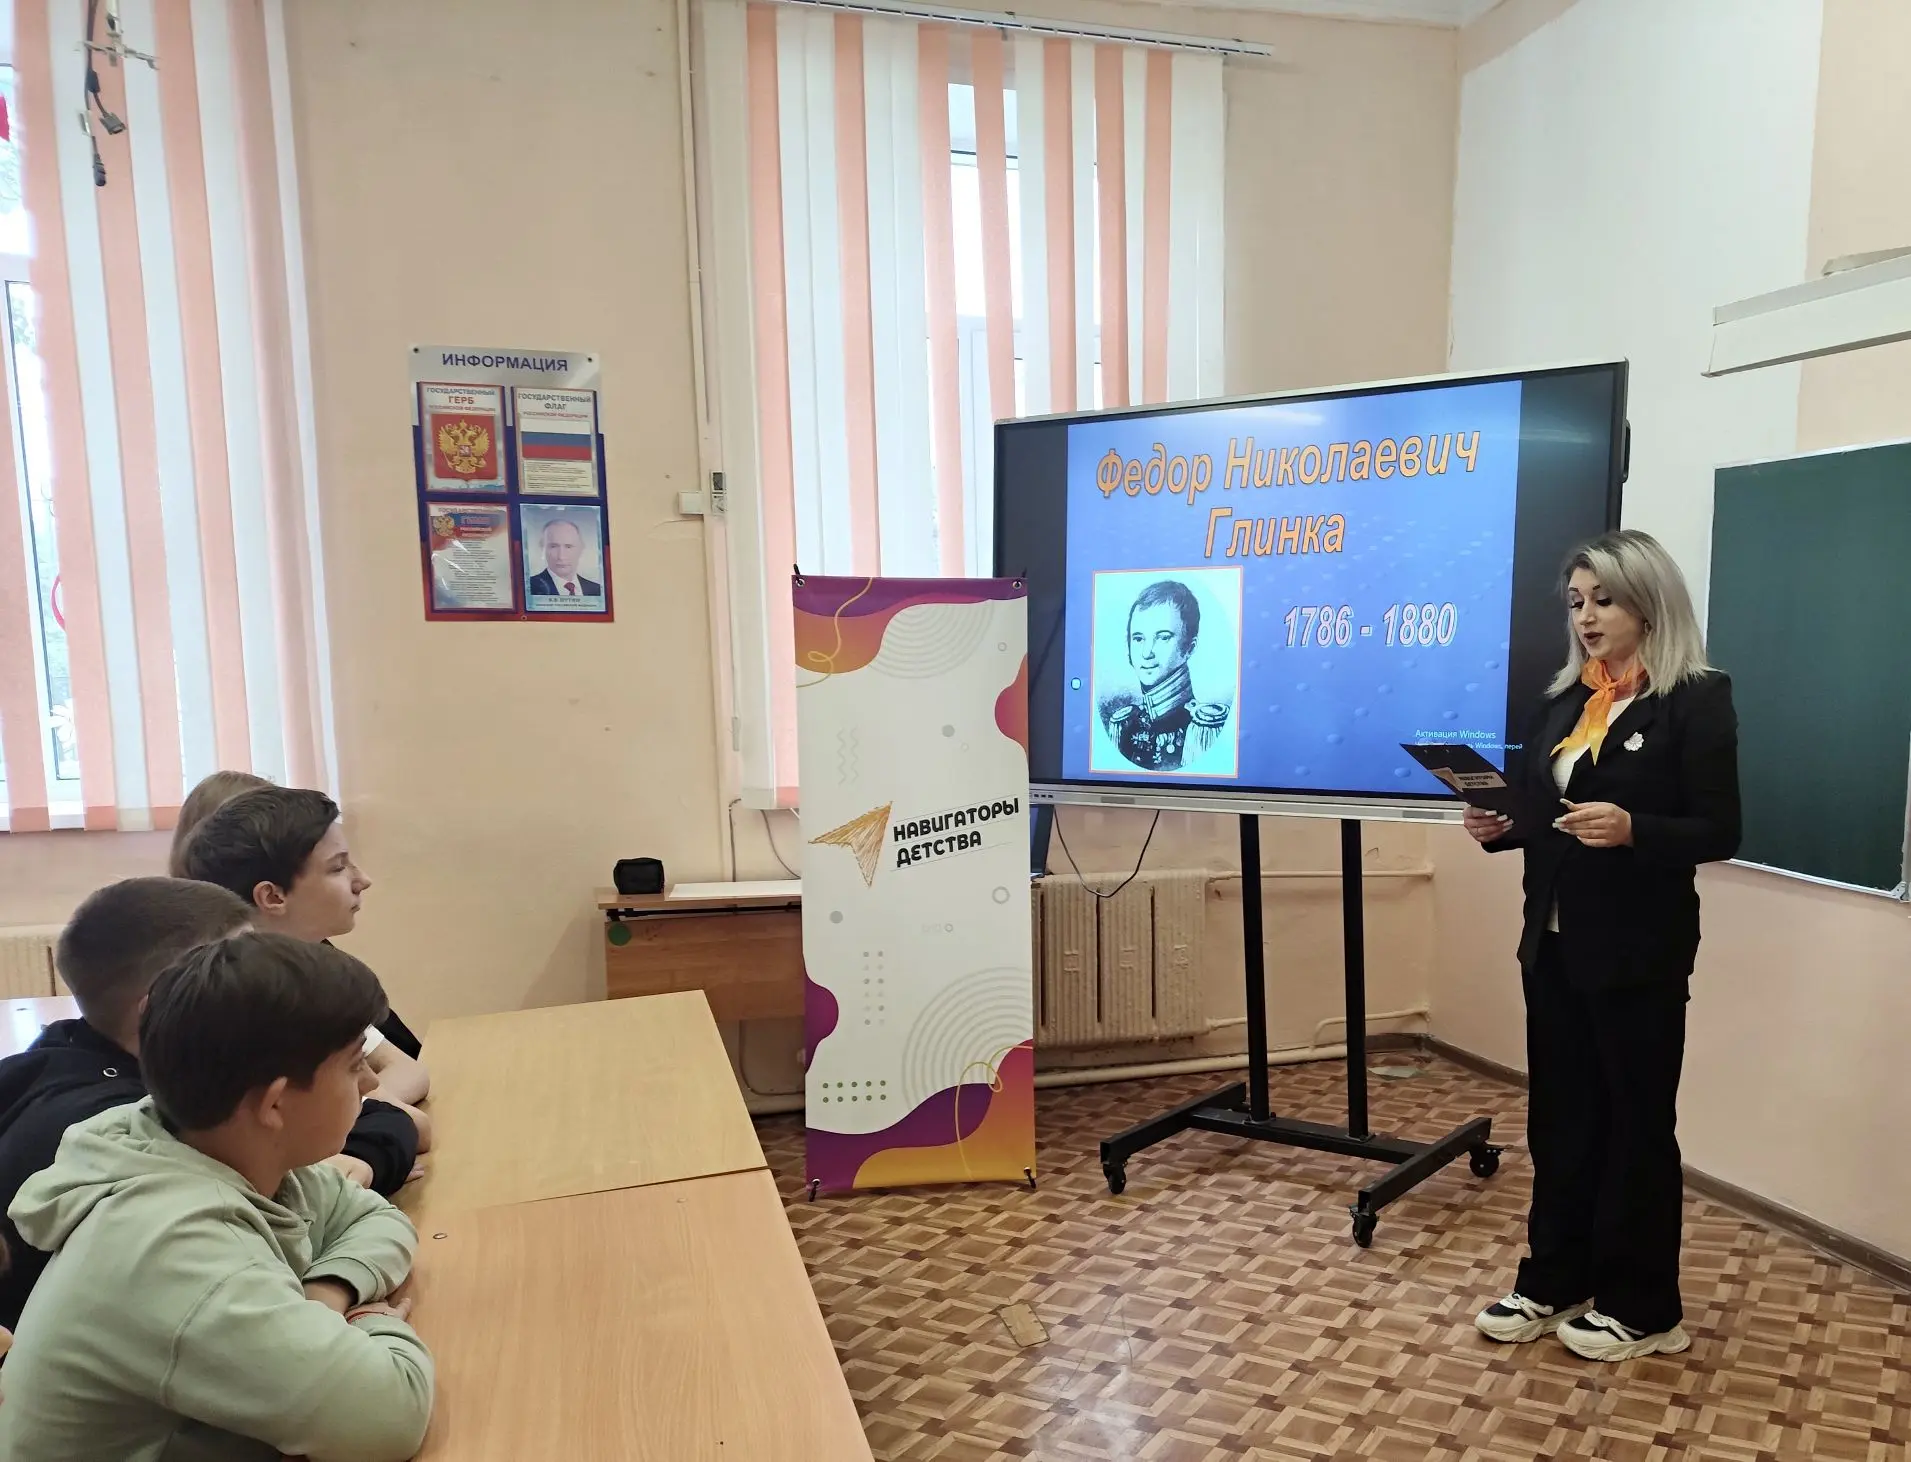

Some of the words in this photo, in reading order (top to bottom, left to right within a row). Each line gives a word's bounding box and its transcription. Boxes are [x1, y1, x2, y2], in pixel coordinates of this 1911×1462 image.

[441, 353, 569, 372] ИНФОРМАЦИЯ
[448, 395, 475, 405] ГЕРБ
[517, 392, 591, 403] ГОСУДАРСТВЕННЫЙ
[544, 402, 567, 410] ФЛАГ
[1096, 442, 1214, 505] Федор
[1223, 430, 1481, 490] Николаевич
[1204, 507, 1346, 558] Глинка
[1283, 604, 1354, 648] 1786
[1359, 623, 1373, 637] -
[1382, 602, 1458, 647] 1880
[1415, 729, 1457, 739] Активация
[1459, 730, 1497, 739] Windows
[893, 798, 1019, 842] НАВИГАТОРЫ
[896, 830, 982, 868] ДЕТСТВА
